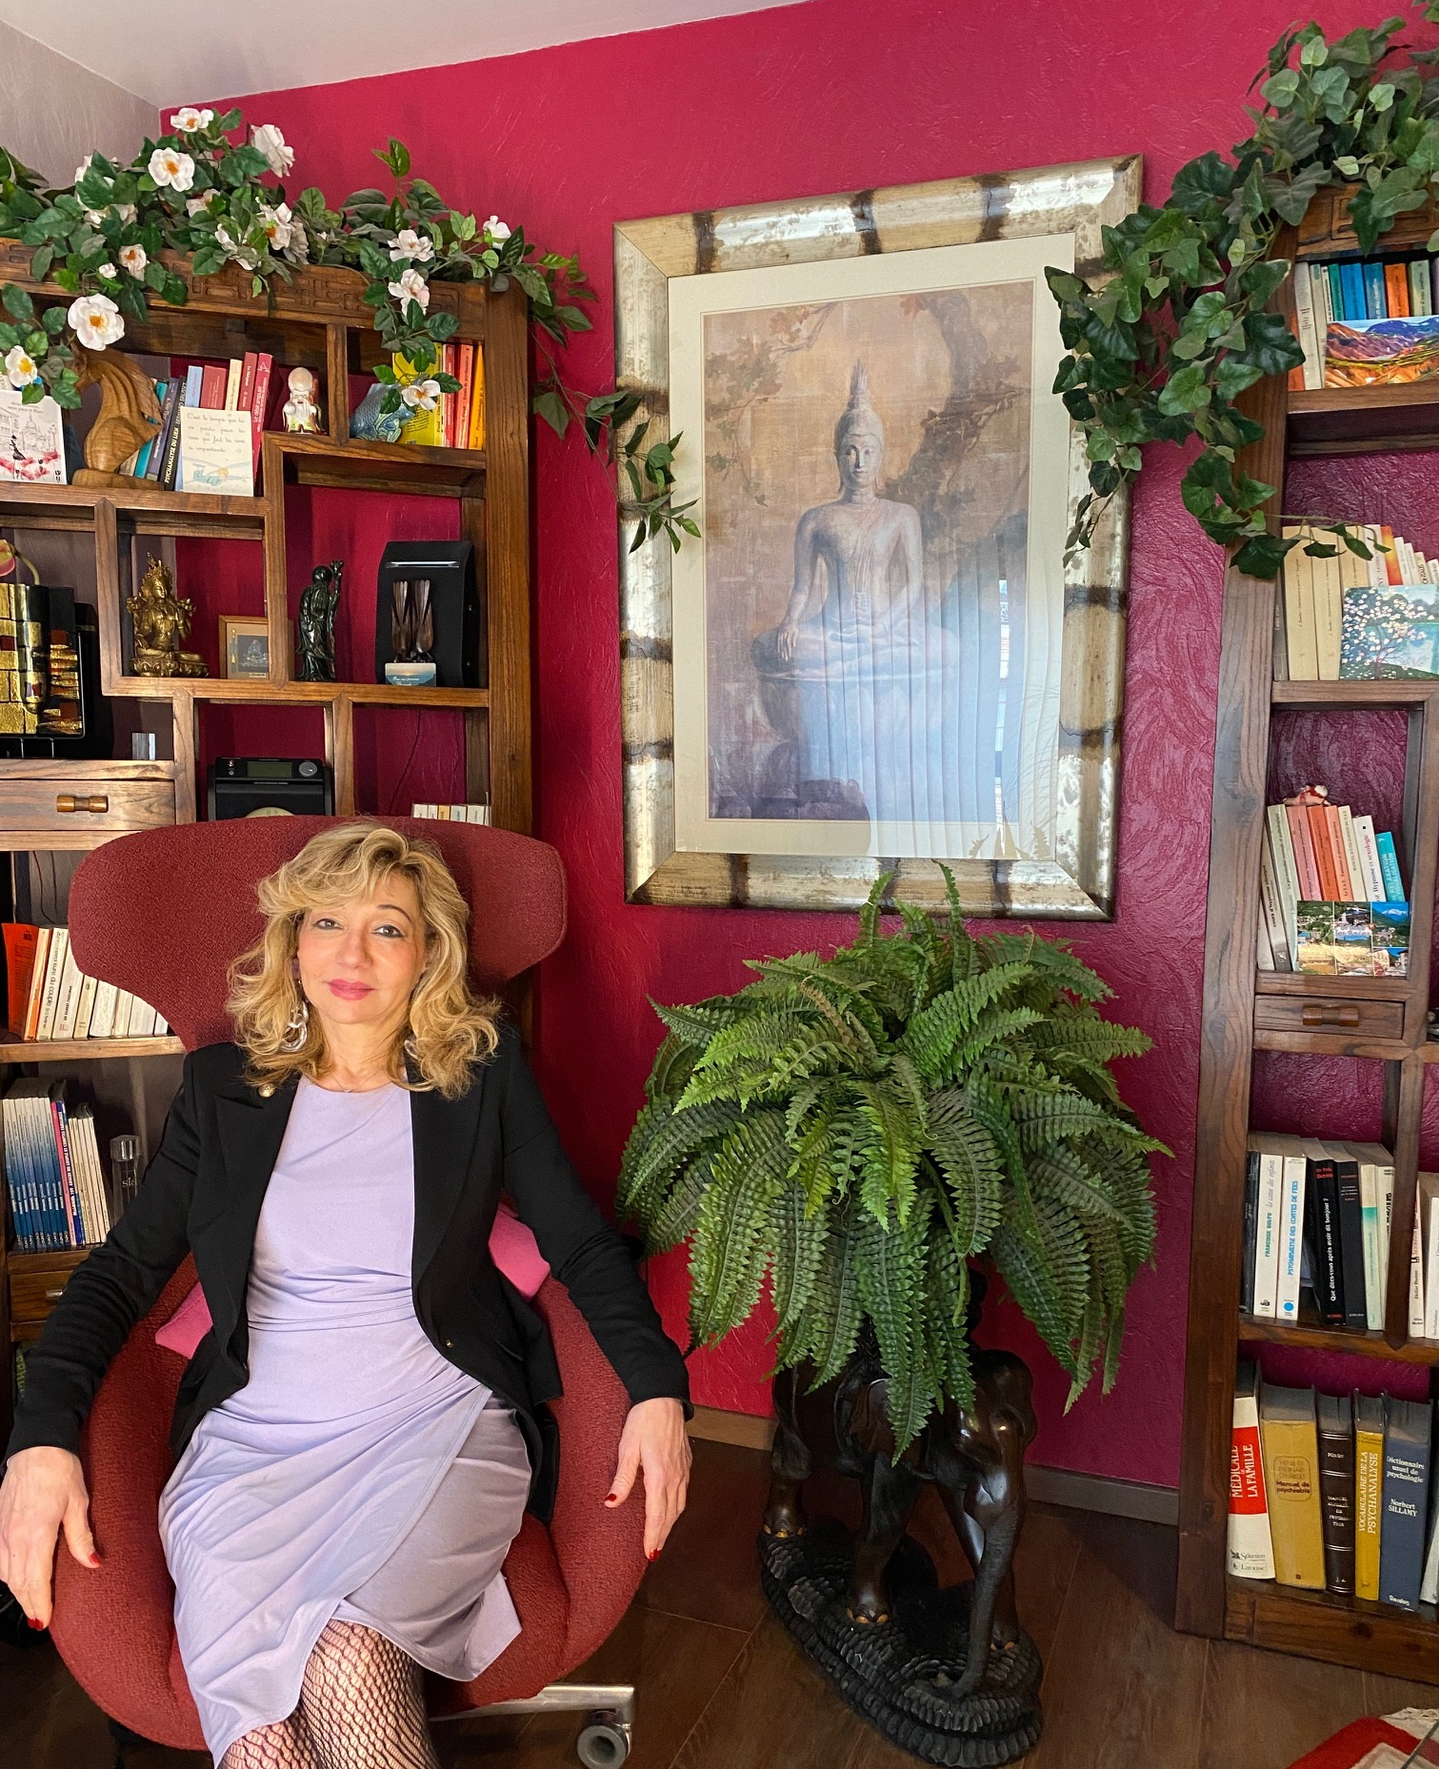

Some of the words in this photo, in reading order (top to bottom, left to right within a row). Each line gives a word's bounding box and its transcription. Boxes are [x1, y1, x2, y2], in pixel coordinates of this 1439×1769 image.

[165, 447, 176, 483] PSYCHANALYSE
[1363, 834, 1373, 861] sexologie
[1369, 867, 1380, 892] Hypnose
[1382, 854, 1395, 893] RELAXATION
[1266, 886, 1275, 912] d'hypnose
[50, 977, 56, 985] du
[45, 987, 54, 1006] couple
[1323, 1203, 1332, 1223] bonjour
[1243, 1444, 1256, 1484] FAMILLE
[1361, 1452, 1367, 1462] LA
[1386, 1455, 1425, 1470] Dictionnaire
[1361, 1463, 1367, 1474] DE
[1386, 1470, 1424, 1484] psychologie
[1392, 1465, 1410, 1475] usuel
[1410, 1466, 1418, 1476] de
[1247, 1485, 1258, 1497] LA
[1368, 1453, 1378, 1534] PSYCHANALYSE
[1359, 1476, 1367, 1532] VOCABULAIRE
[1388, 1504, 1418, 1518] SILLAMY
[1390, 1498, 1416, 1510] Norbert
